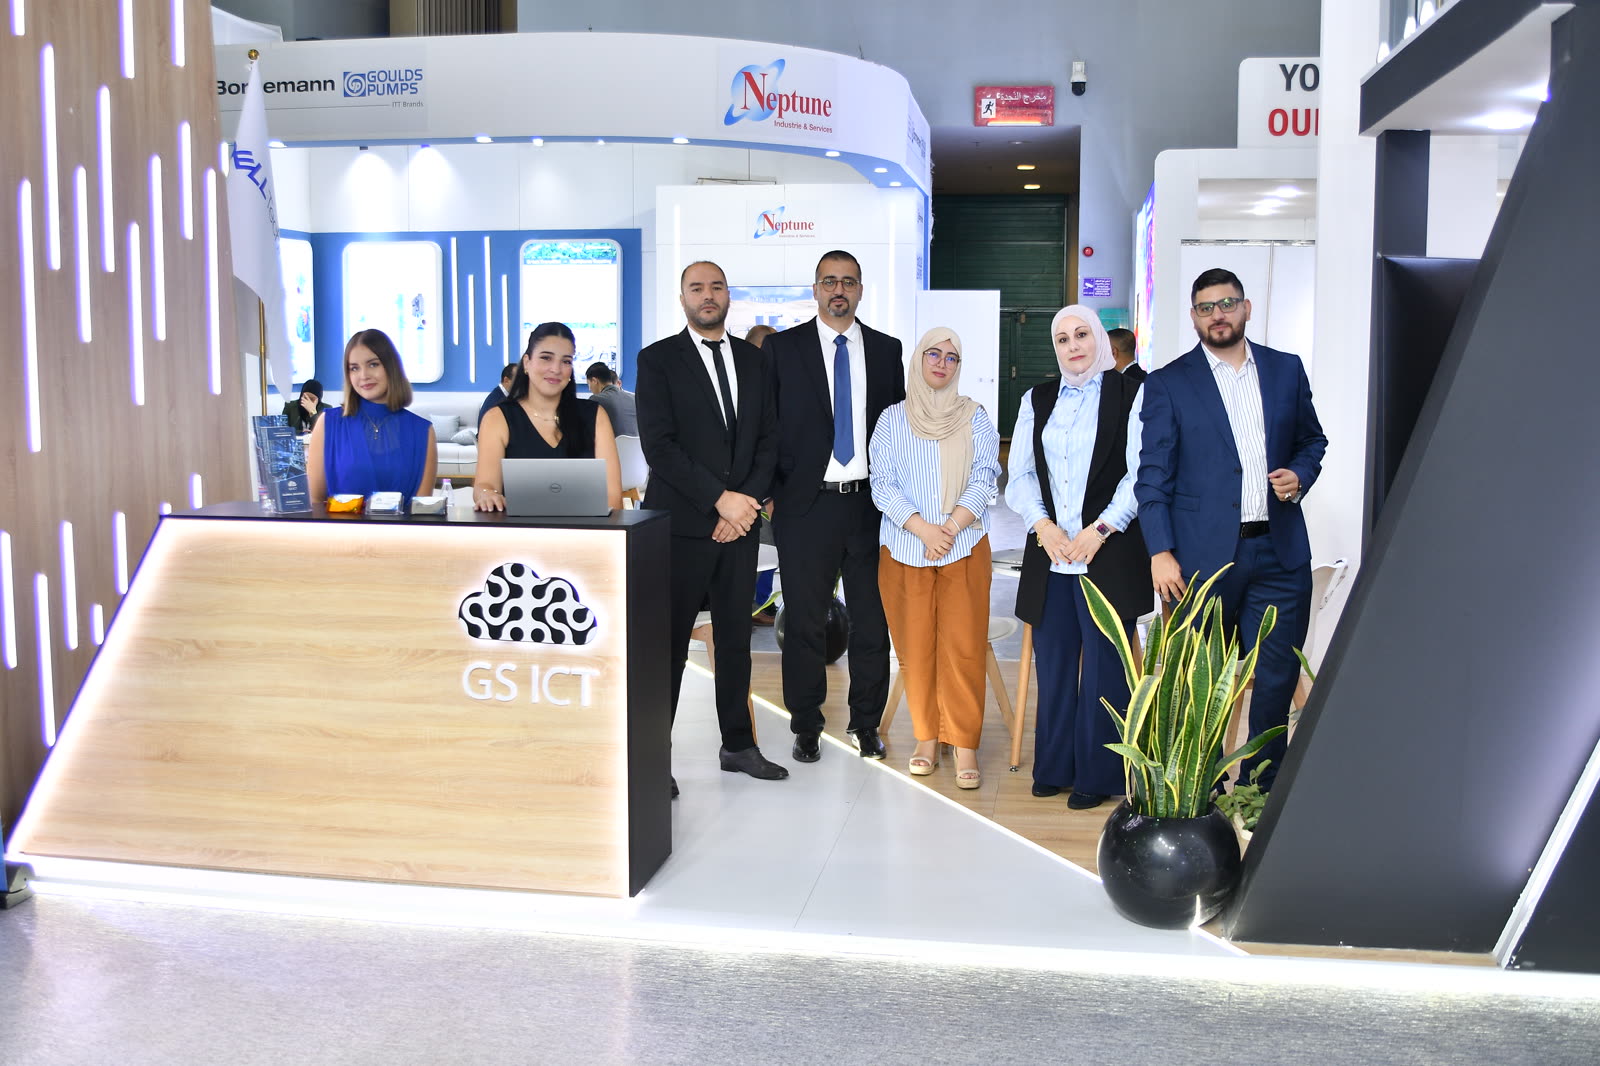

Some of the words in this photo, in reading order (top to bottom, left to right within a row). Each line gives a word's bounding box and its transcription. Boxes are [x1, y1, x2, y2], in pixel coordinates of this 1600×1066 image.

[366, 69, 423, 83] GOULDS
[217, 79, 335, 95] Boremann
[367, 82, 418, 97] PUMPS
[740, 71, 832, 119] Neptune
[774, 120, 802, 130] Industrie
[809, 124, 833, 133] Services
[1267, 108, 1319, 137] OU
[762, 213, 815, 234] Neptune
[462, 661, 518, 702] GS
[530, 663, 601, 707] ICT
